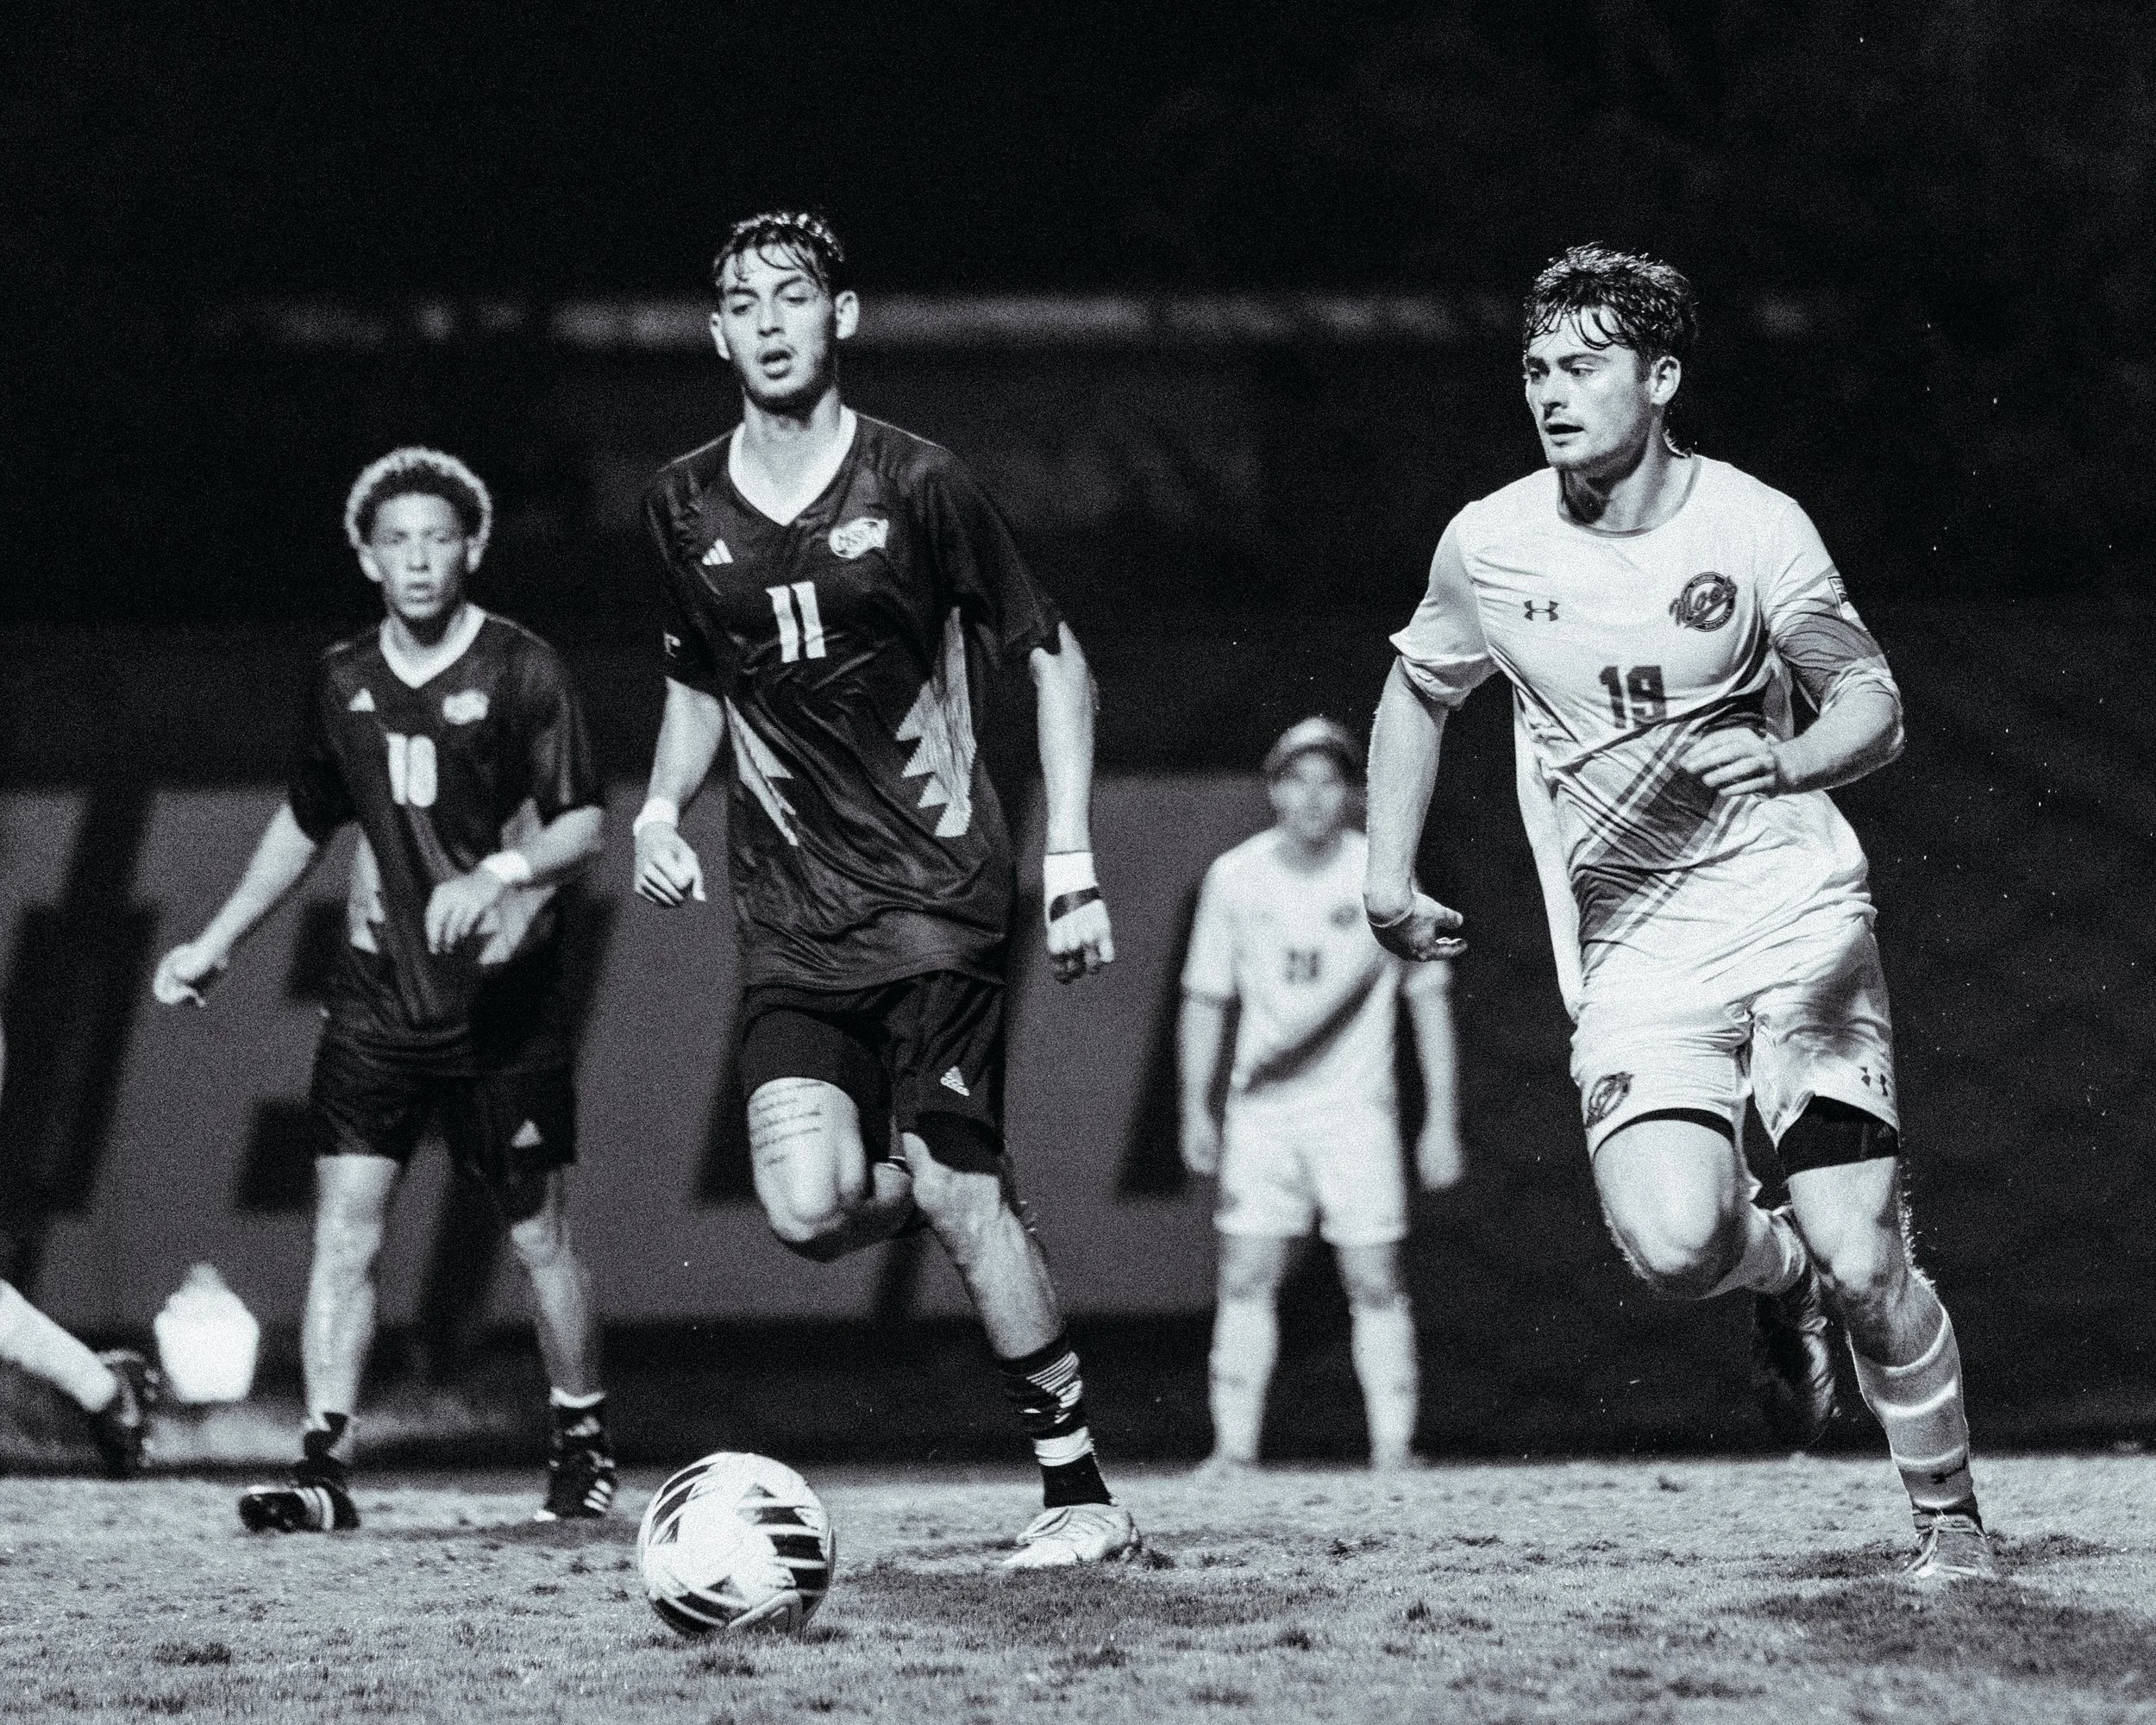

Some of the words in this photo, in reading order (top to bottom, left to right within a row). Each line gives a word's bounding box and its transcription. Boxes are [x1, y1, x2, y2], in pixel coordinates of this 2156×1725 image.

[765, 580, 826, 662] 11
[1599, 665, 1667, 729] 19
[385, 732, 438, 808] 10
